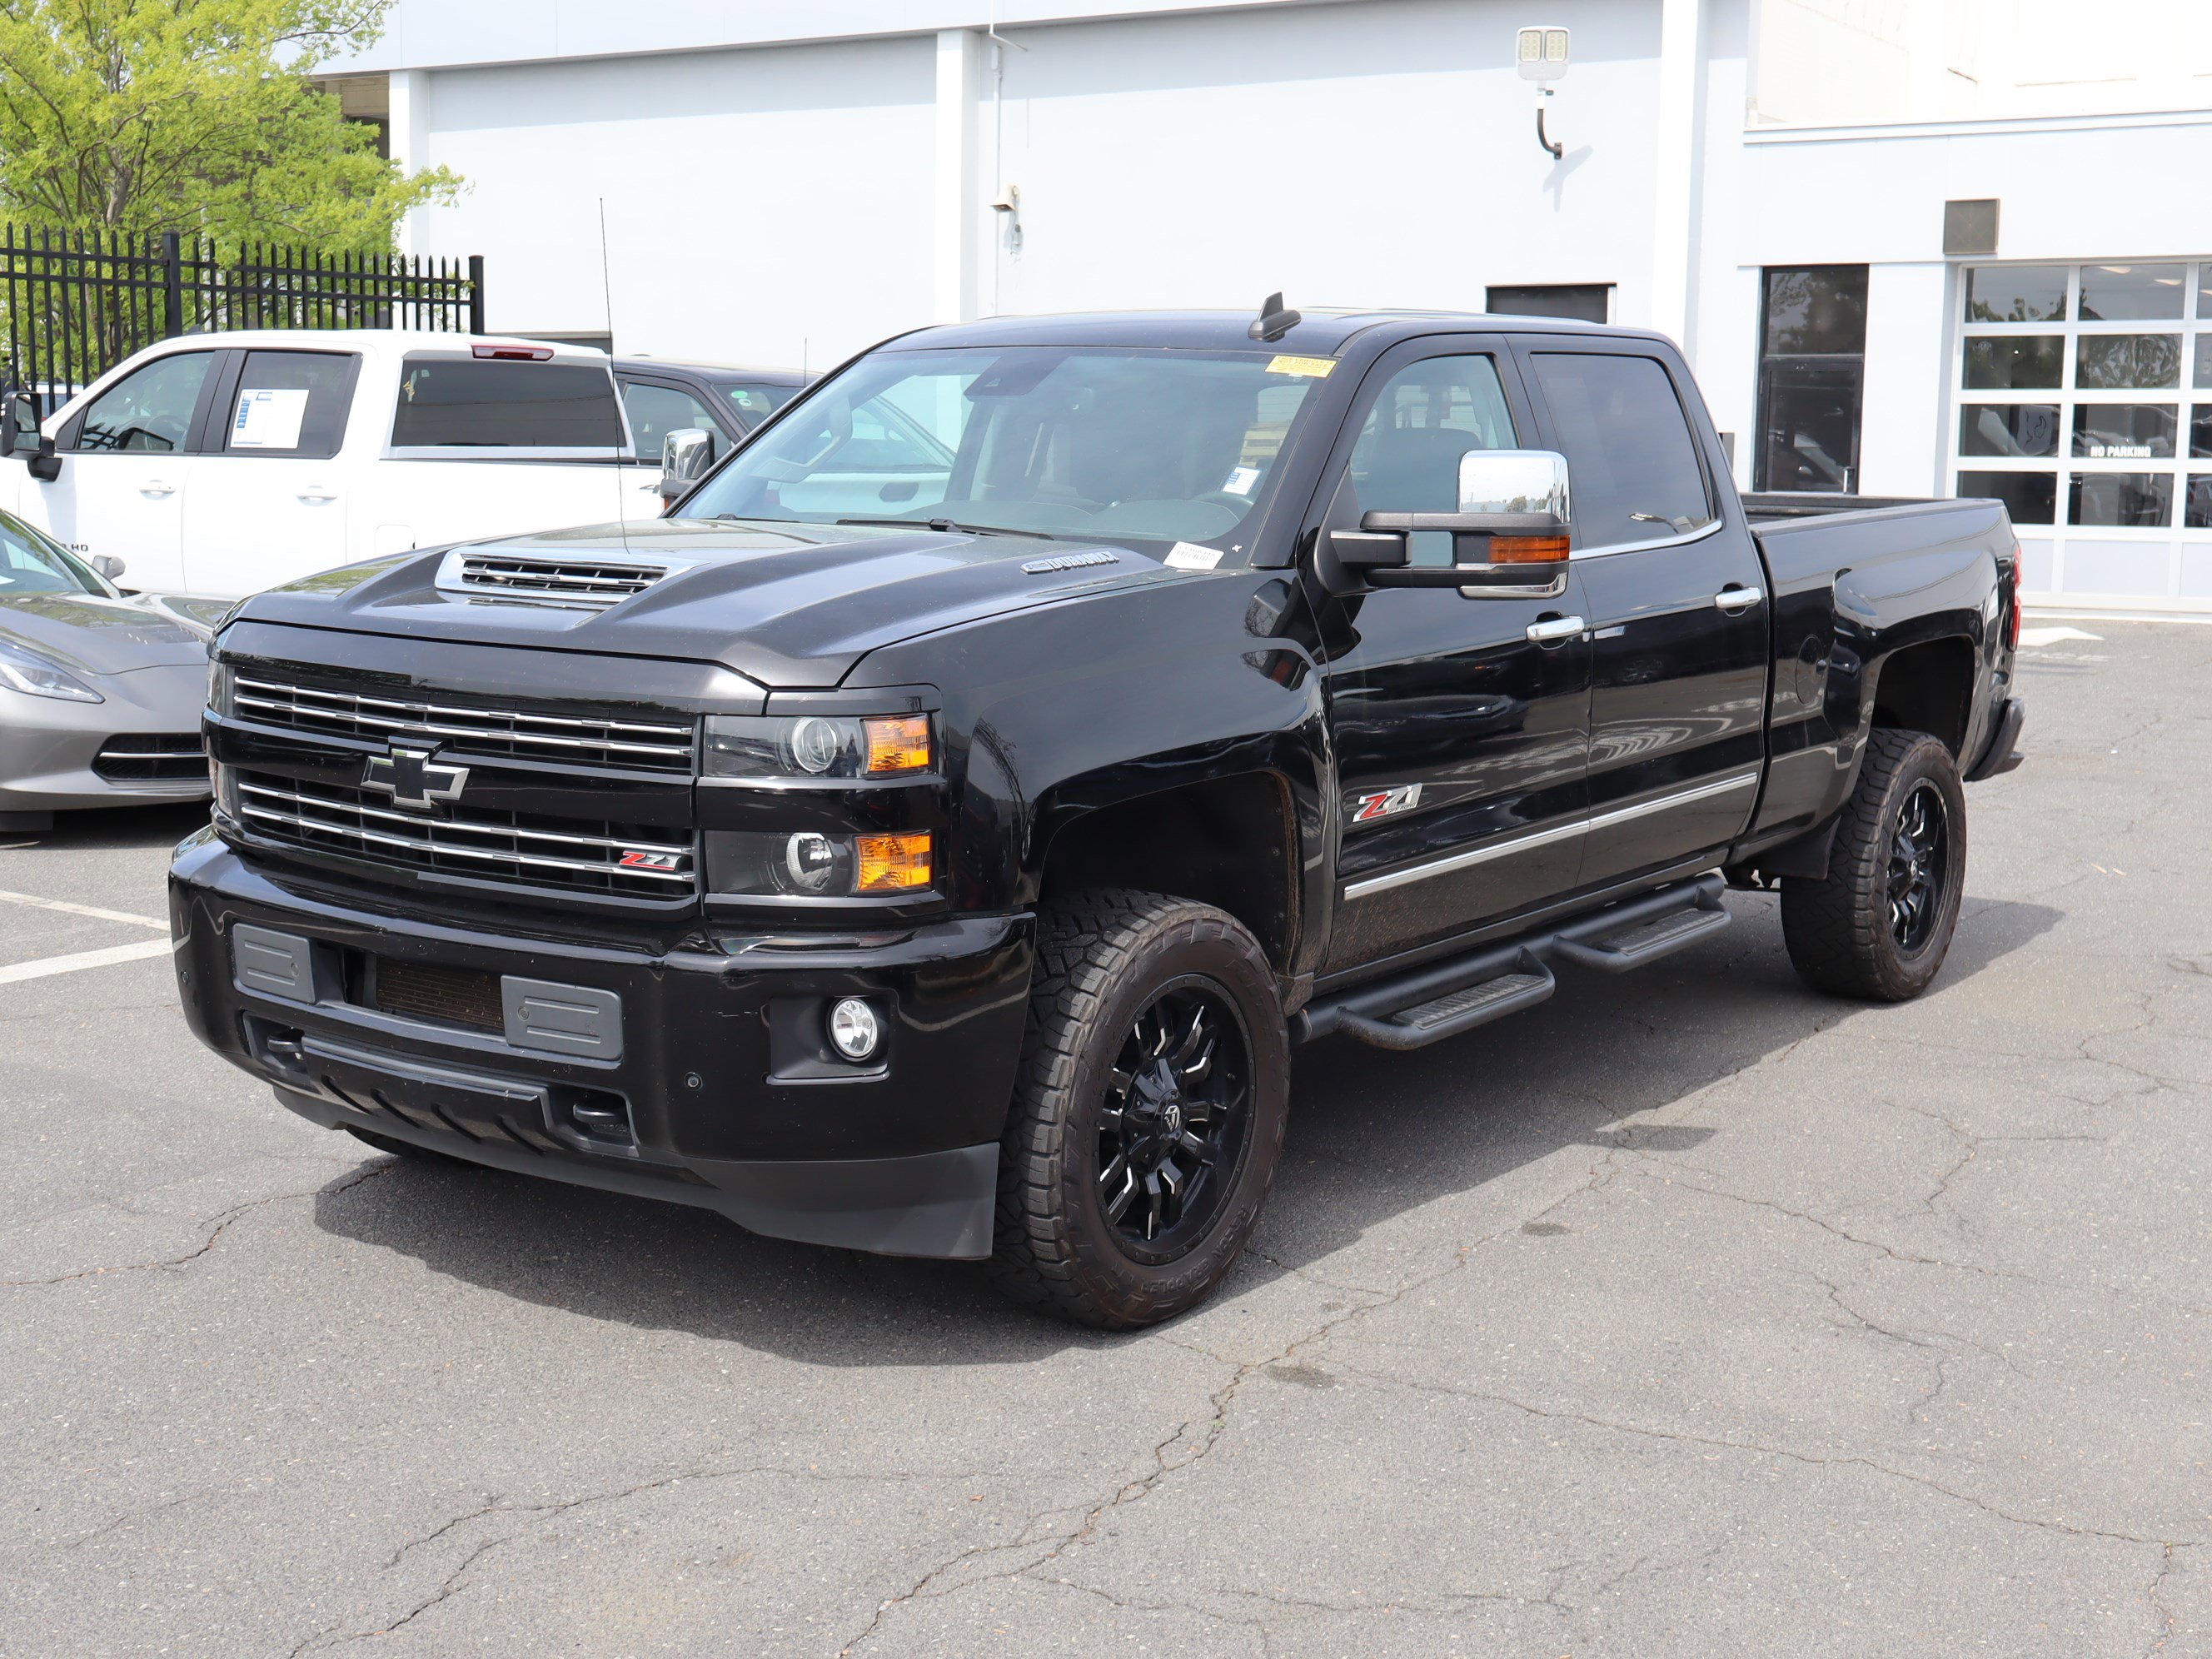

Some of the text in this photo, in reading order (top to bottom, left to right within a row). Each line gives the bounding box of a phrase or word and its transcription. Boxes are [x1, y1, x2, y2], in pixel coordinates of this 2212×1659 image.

[2090, 446, 2152, 457] NO PARKING
[1044, 551, 1119, 572] DURAMAX
[1352, 782, 1423, 823] Z71
[619, 849, 681, 871] Z71
